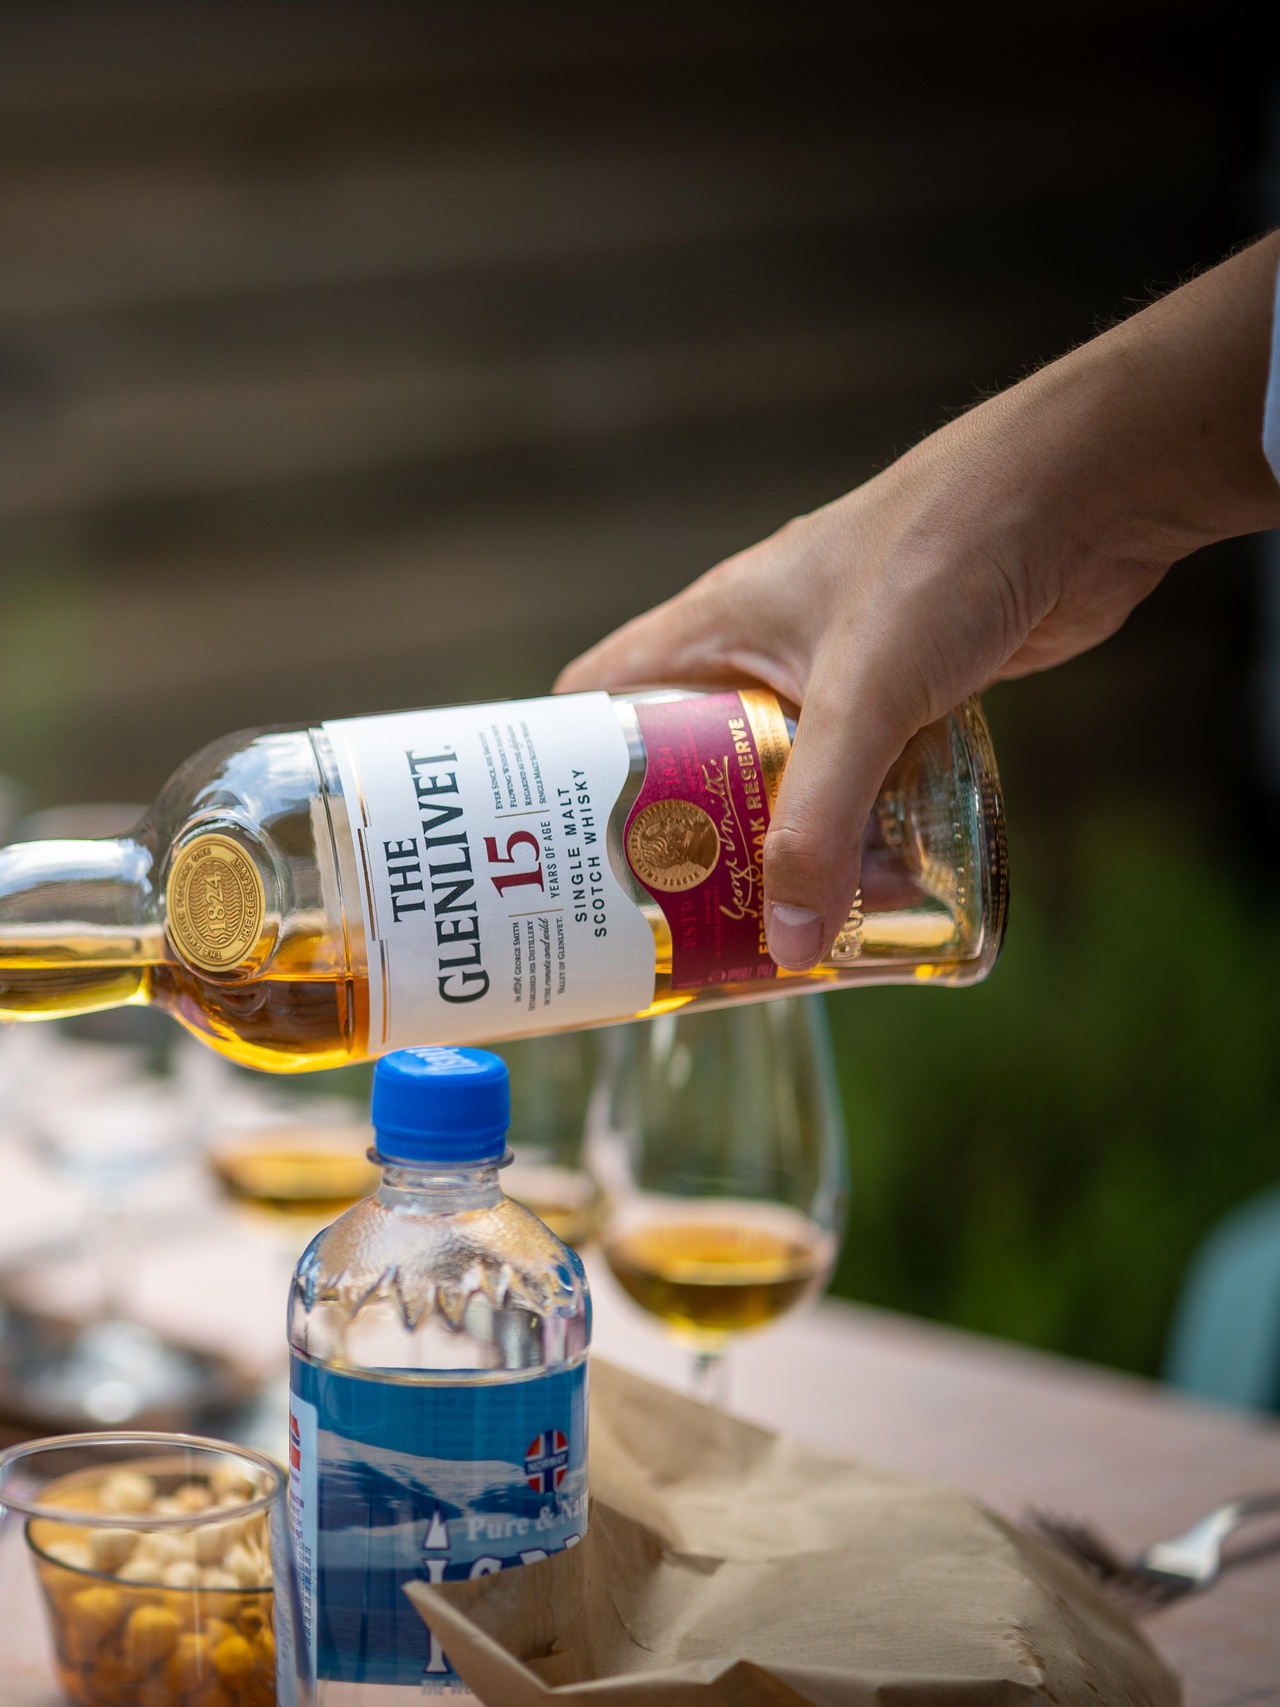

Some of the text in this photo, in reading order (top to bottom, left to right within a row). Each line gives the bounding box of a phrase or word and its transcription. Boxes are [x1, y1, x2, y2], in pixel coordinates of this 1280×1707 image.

[532, 761, 541, 779] MALT
[658, 747, 679, 784] 1824
[728, 717, 762, 809] RESERVE
[494, 790, 503, 810] EVER
[505, 775, 518, 808] FLOWING
[520, 771, 532, 806] REGARDED
[536, 779, 546, 804] SINGLE
[191, 847, 211, 862] ONE
[558, 788, 588, 922] SINGLE MALT
[573, 769, 607, 937] SCOTCH WHISKY
[750, 816, 765, 864] OAK
[483, 831, 544, 898] 15
[541, 821, 560, 899] YEARS OF AGE
[383, 838, 426, 922] THE
[203, 874, 227, 933] 1824
[230, 857, 256, 942] THE GLENLIVET
[178, 911, 201, 953] SMOOTH
[527, 920, 536, 961] DISTILLERY
[538, 917, 550, 941] wild
[556, 916, 565, 960] GLENLIVET.
[202, 949, 222, 960] THE
[514, 947, 522, 975] GEORGE
[539, 938, 550, 960] and
[527, 1453, 567, 1473] NORWAY
[467, 1516, 529, 1542] Pure
[536, 1505, 555, 1531] &
